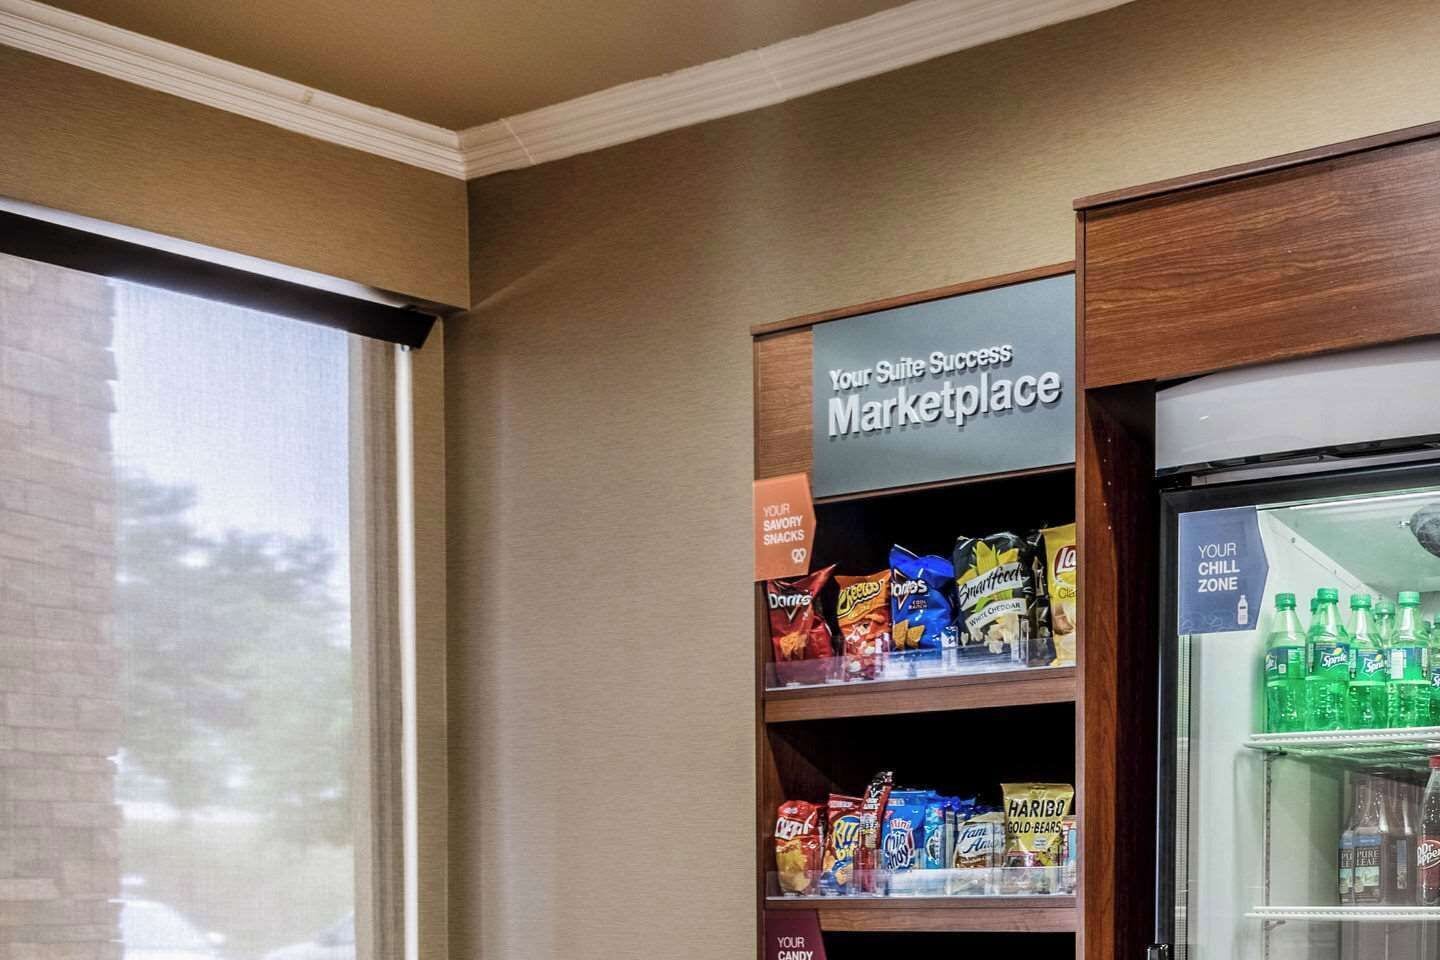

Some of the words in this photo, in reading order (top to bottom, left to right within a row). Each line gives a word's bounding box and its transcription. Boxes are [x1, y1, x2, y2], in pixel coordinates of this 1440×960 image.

[829, 365, 872, 390] Your
[876, 357, 925, 384] Suite
[929, 344, 1013, 374] Success
[828, 370, 1062, 437] Marketplace
[763, 503, 791, 517] YOUR
[763, 515, 803, 532] SAVORY
[763, 529, 805, 545] SNACKS
[1198, 542, 1237, 558] YOUR
[1198, 560, 1240, 576] CHILL
[959, 566, 1024, 607] Smartfood
[1198, 576, 1238, 593] ZONE
[1008, 799, 1065, 818] HARIBO
[1357, 847, 1377, 858] PURE
[777, 936, 805, 949] YOUR
